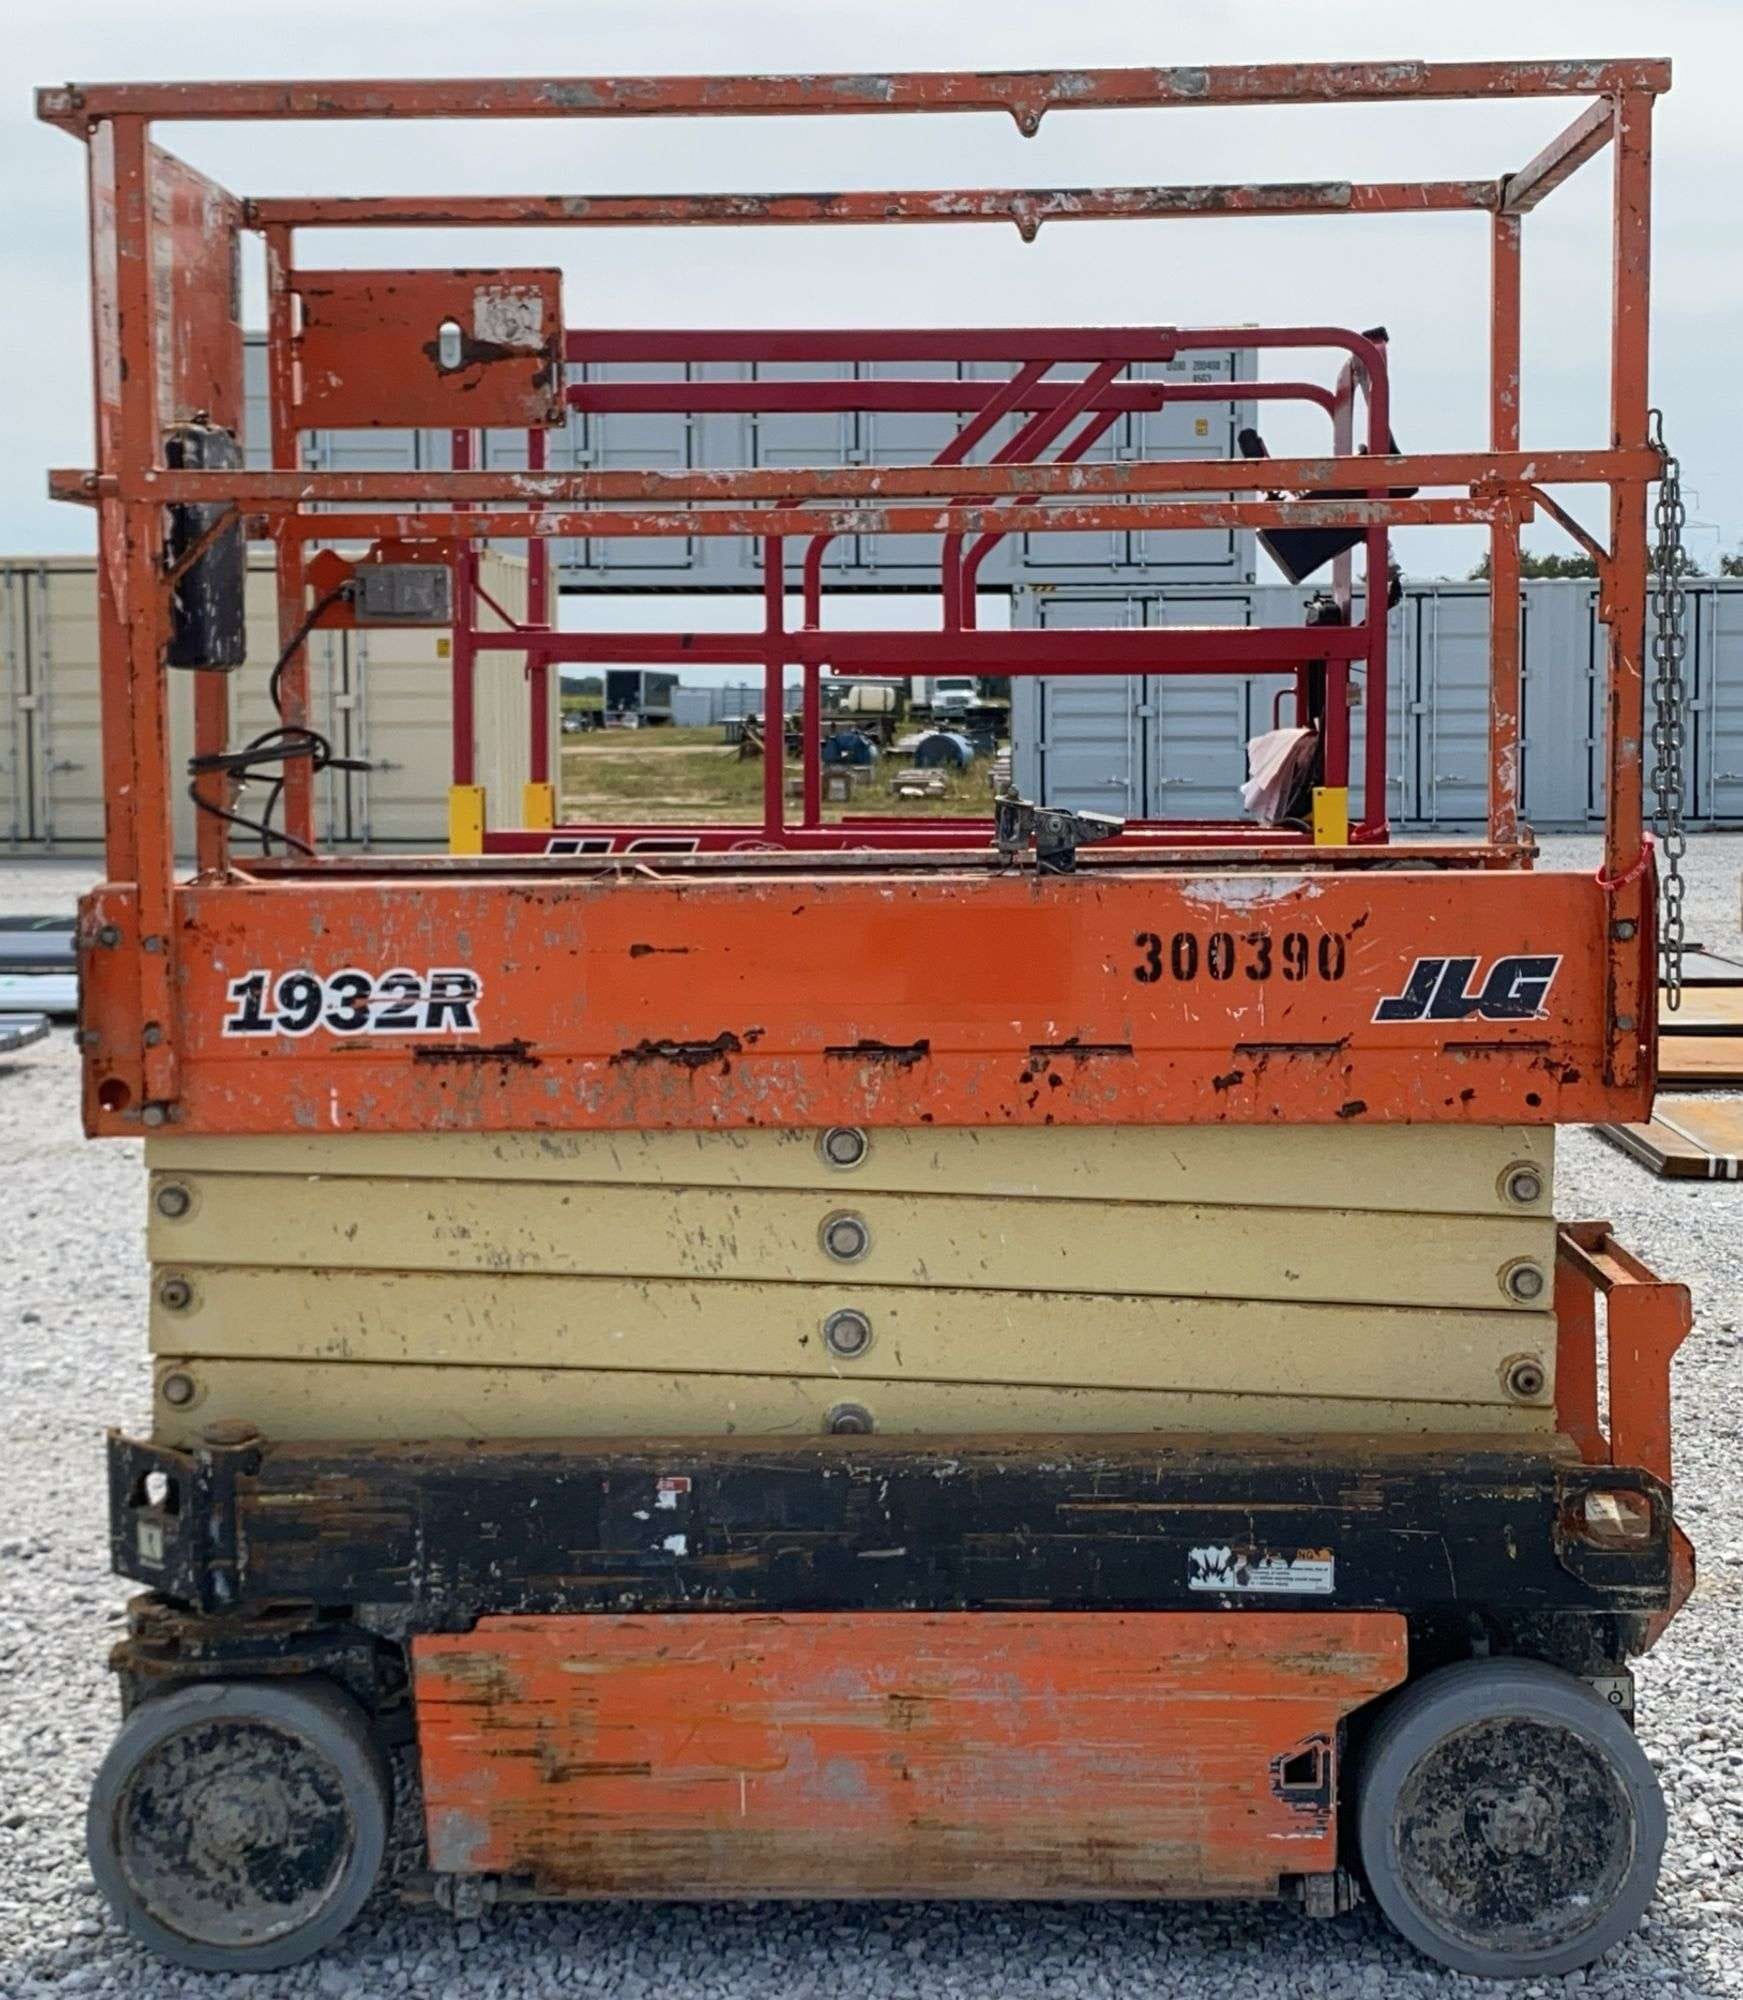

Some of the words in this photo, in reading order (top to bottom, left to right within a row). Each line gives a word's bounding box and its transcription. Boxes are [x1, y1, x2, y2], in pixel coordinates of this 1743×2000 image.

[1133, 932, 1346, 982] 300390
[1370, 954, 1563, 1023] JLG
[222, 969, 480, 1036] 1932R
